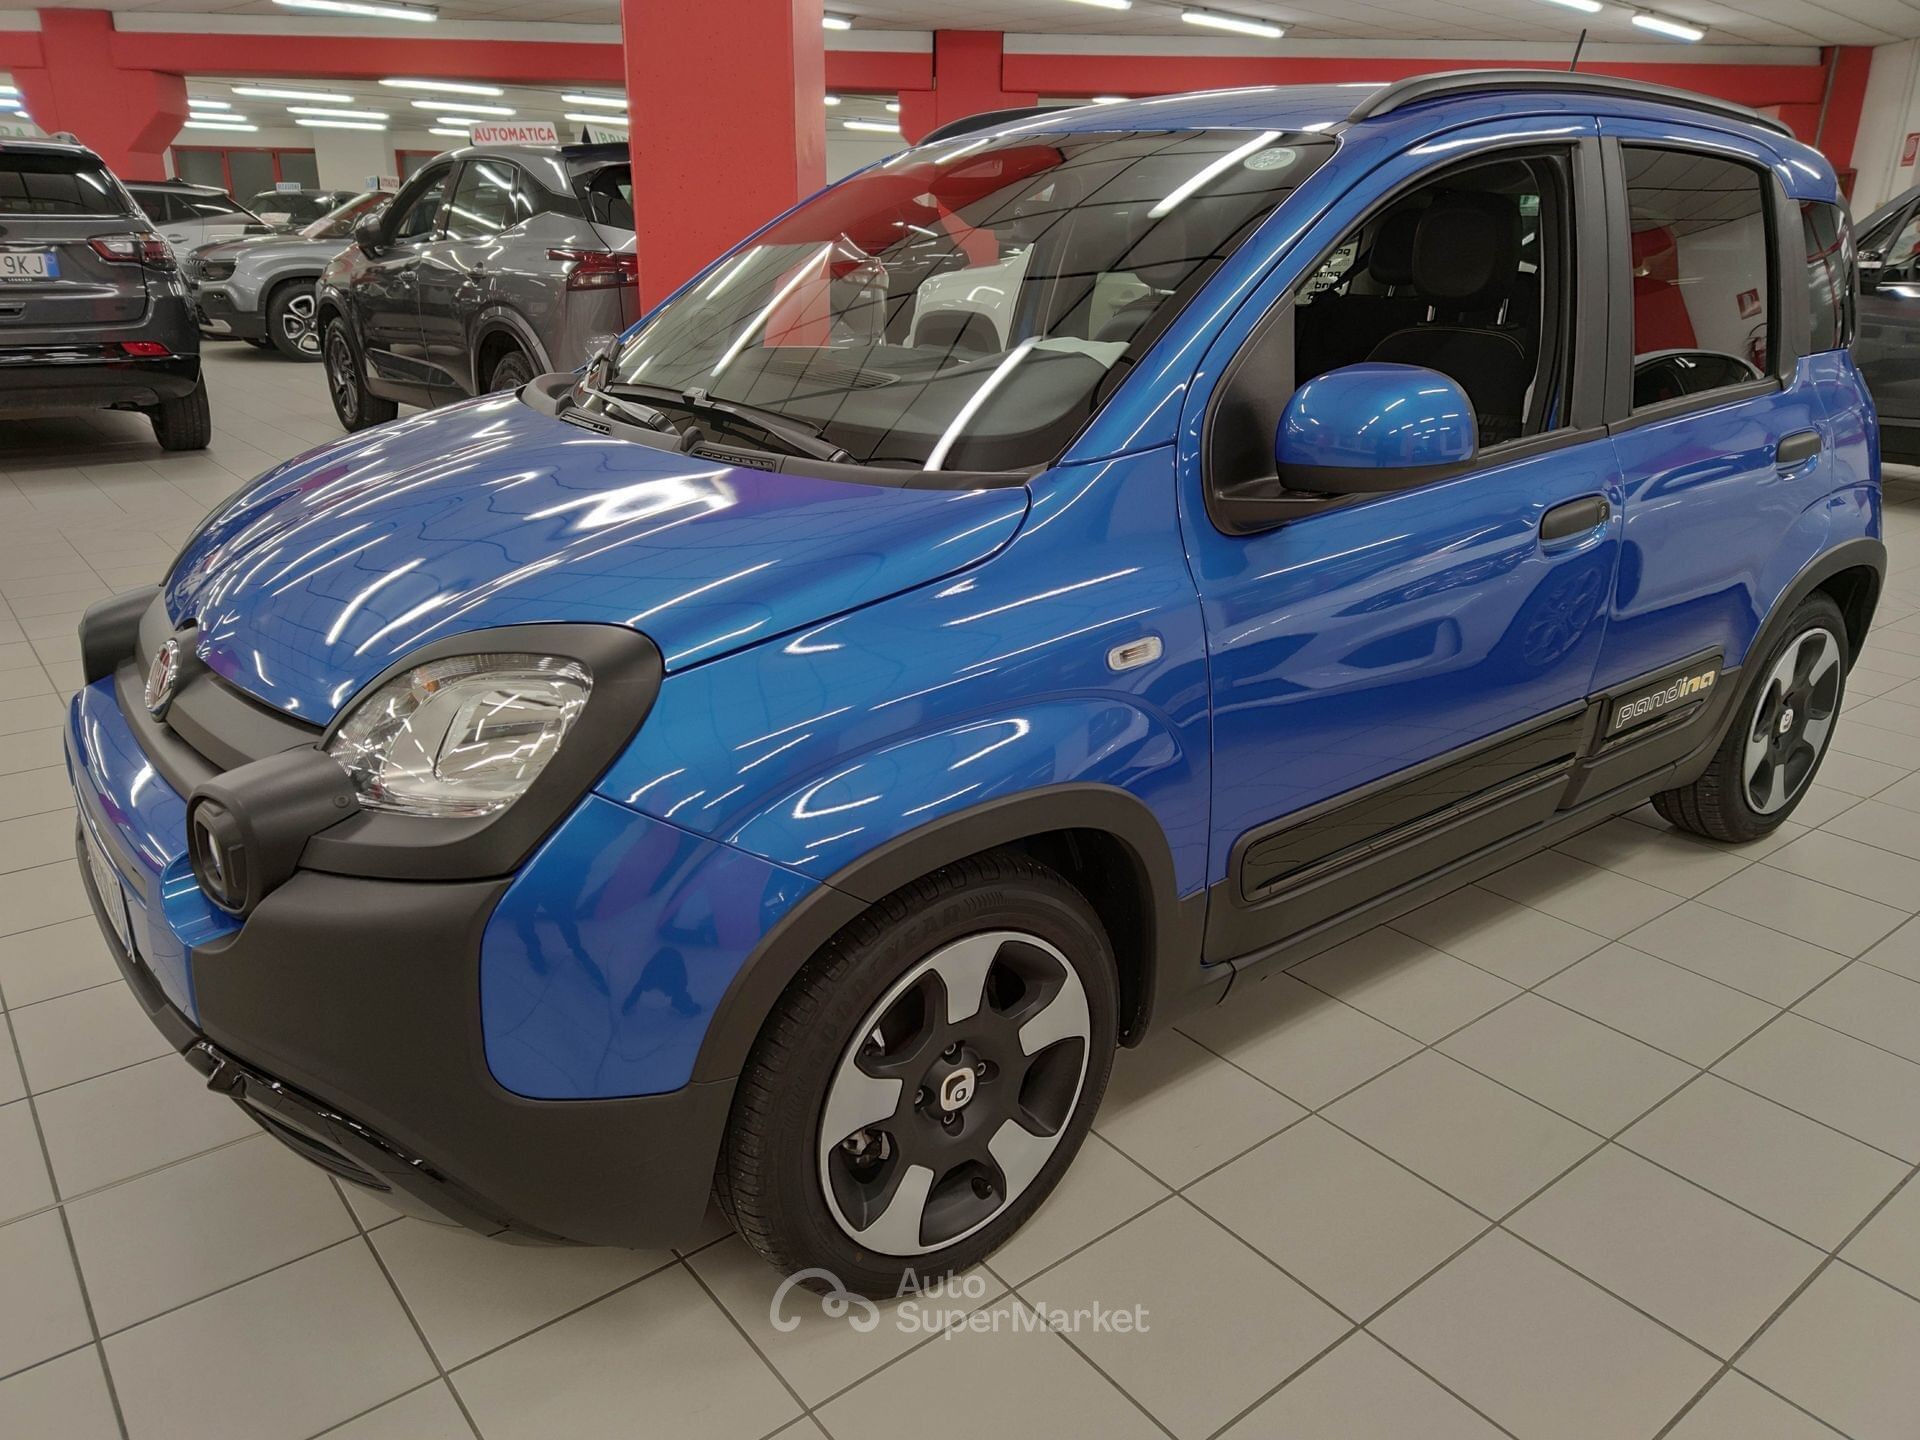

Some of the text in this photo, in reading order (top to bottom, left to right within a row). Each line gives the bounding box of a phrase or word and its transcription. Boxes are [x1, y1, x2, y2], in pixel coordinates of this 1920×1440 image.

[474, 126, 556, 143] AUTOMATICA
[3, 255, 44, 274] 9KJ
[1616, 670, 1716, 729] pandina
